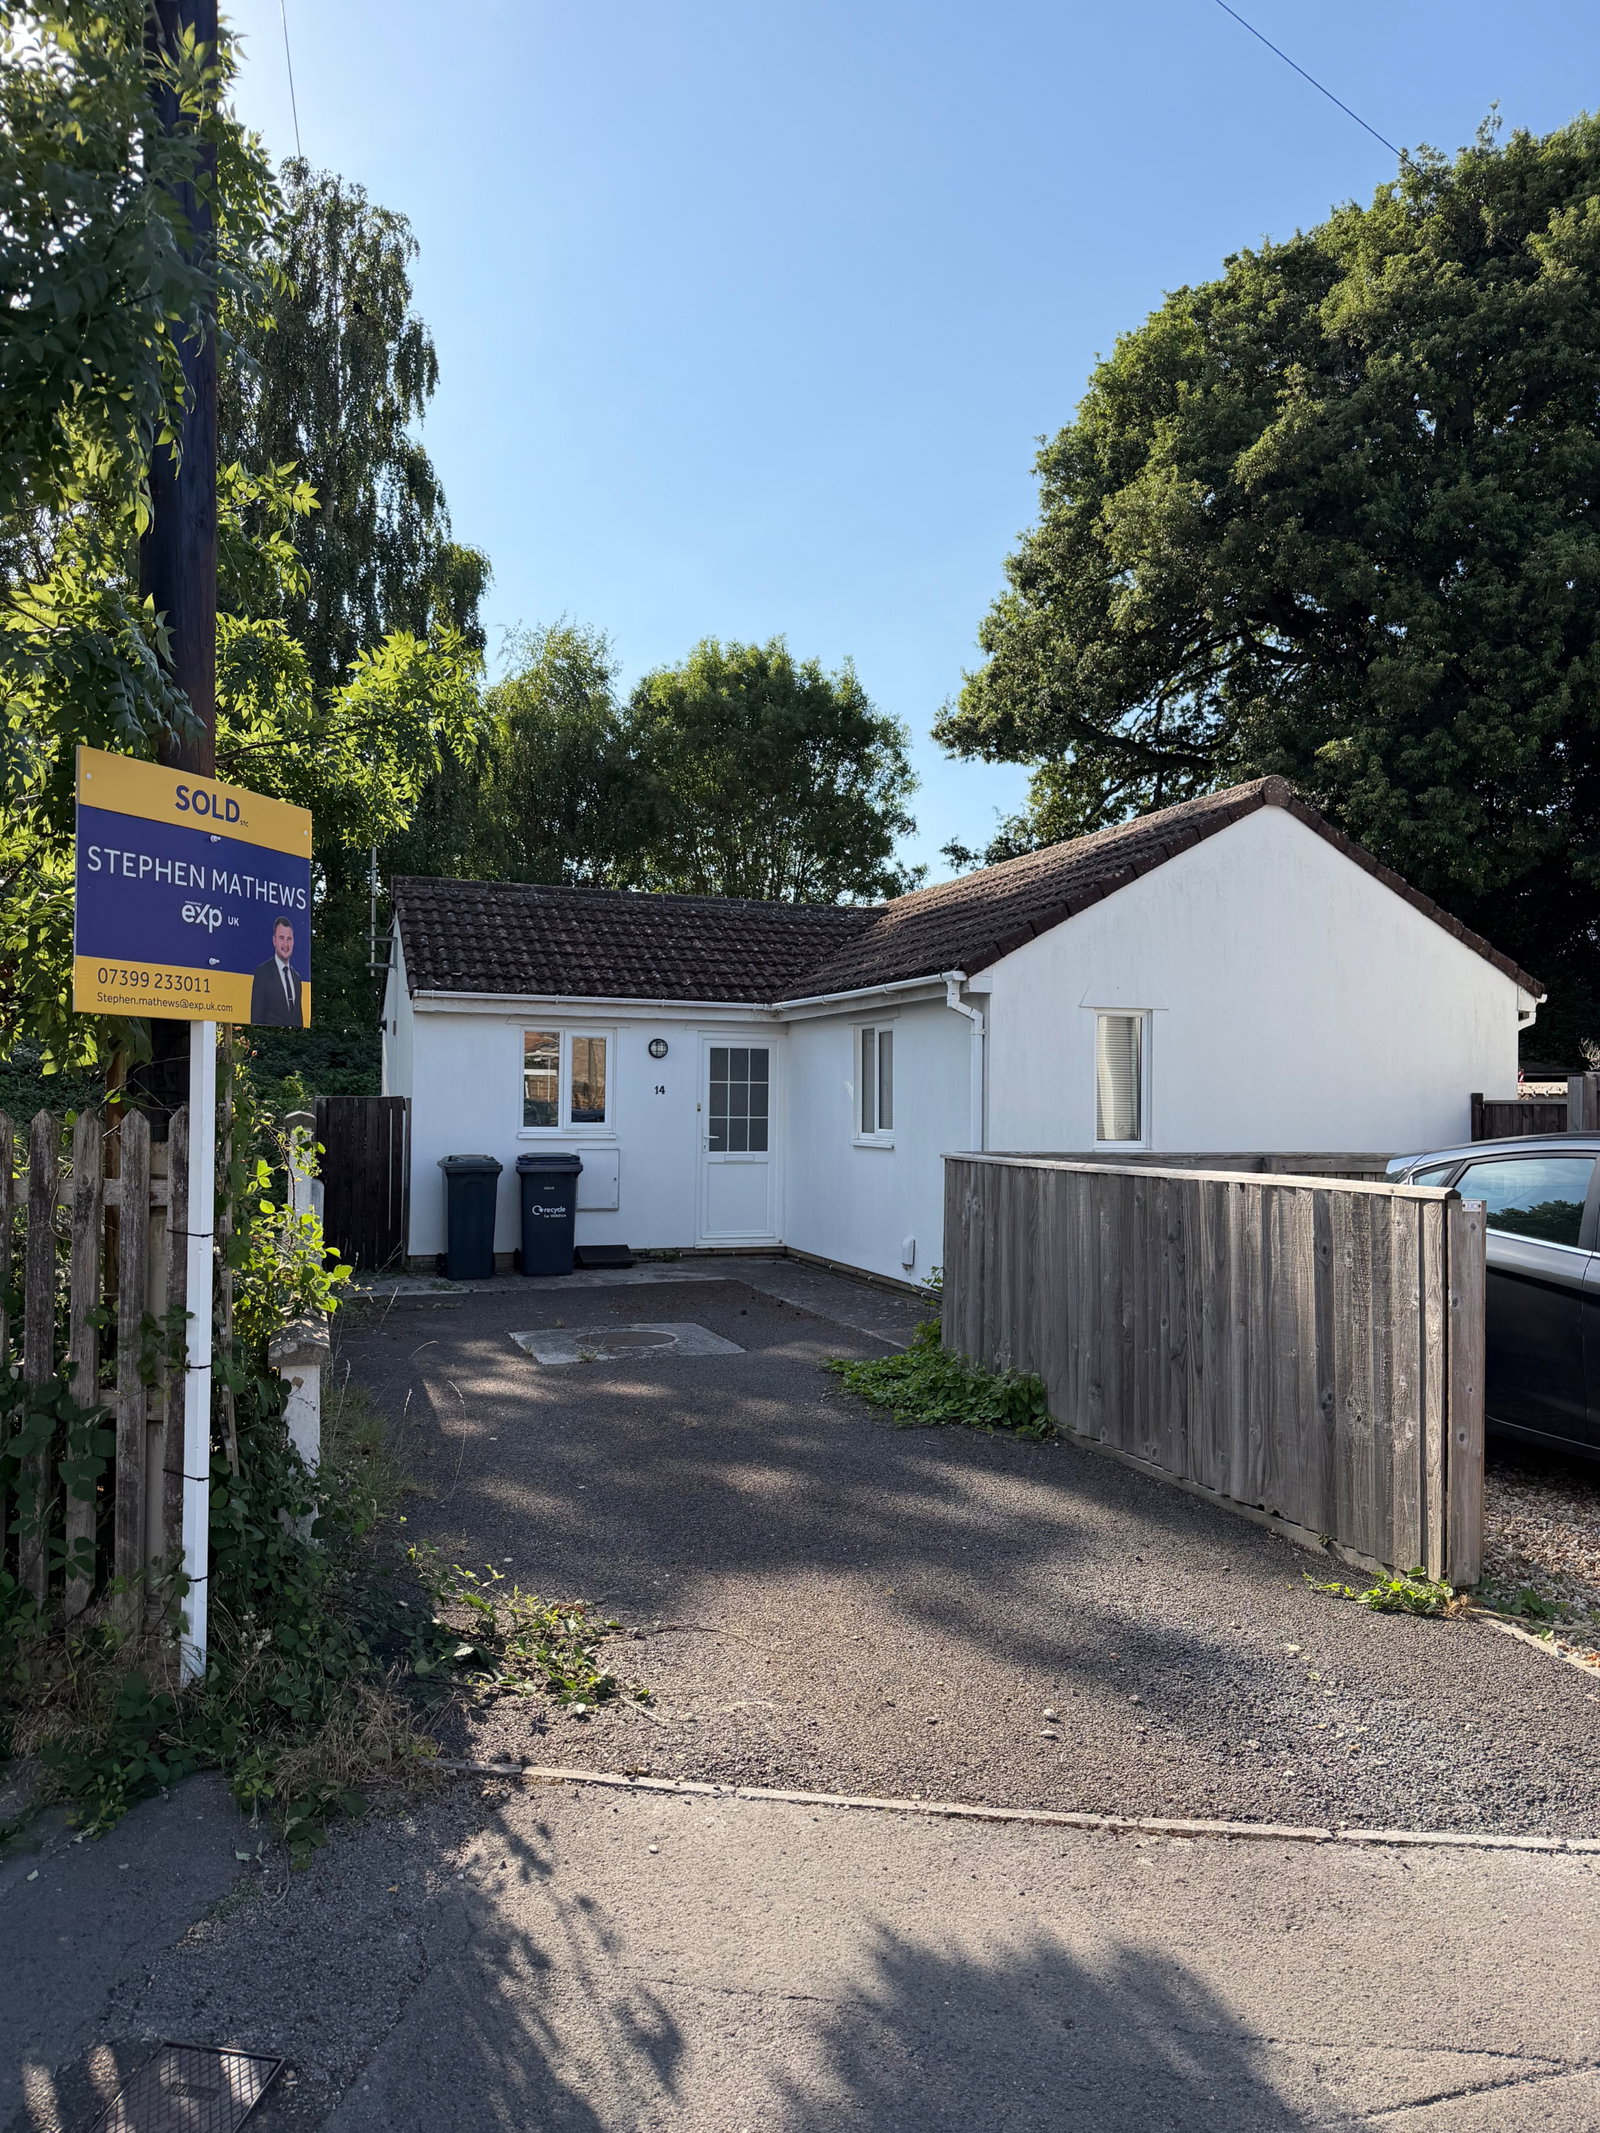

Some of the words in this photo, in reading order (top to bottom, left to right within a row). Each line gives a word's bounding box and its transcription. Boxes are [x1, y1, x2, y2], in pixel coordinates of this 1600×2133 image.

[175, 785, 240, 823] SOLD
[87, 845, 205, 889] STEPHEN
[212, 869, 306, 910] MATHEWS
[227, 915, 240, 927] UK
[97, 967, 150, 988] 07399
[154, 973, 210, 993] 233011
[97, 991, 233, 1012] Stephen.mathews@exp.uk.com
[654, 1085, 666, 1095] 14
[543, 1205, 566, 1214] recycle
